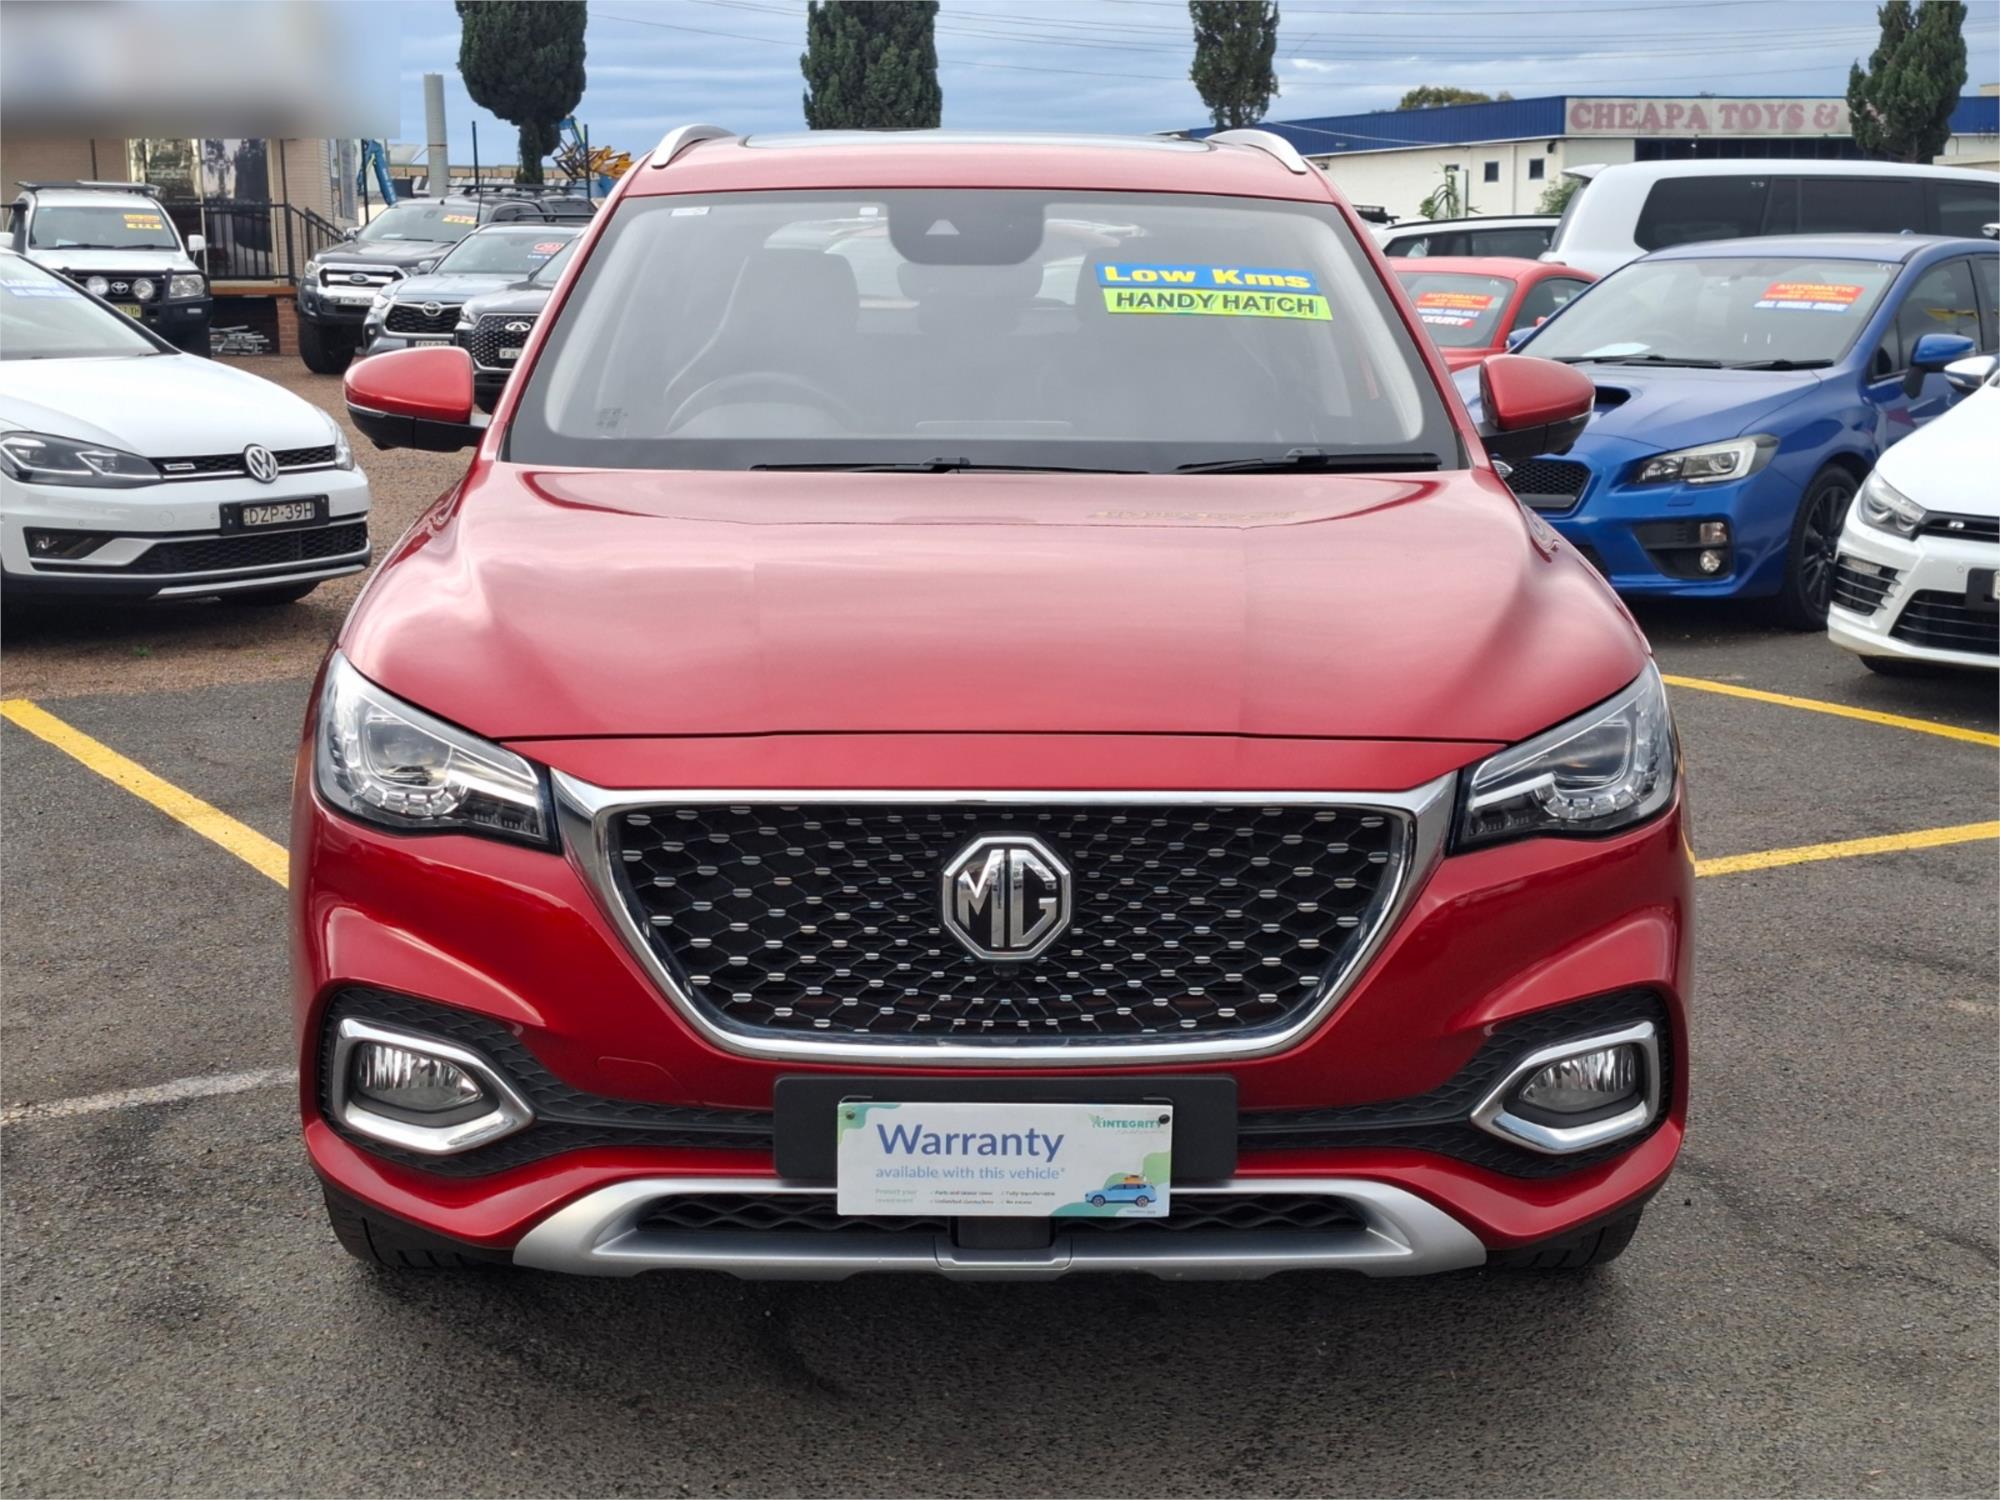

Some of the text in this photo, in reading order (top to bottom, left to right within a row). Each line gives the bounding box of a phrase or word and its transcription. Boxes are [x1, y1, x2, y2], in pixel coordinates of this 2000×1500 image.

[1569, 102, 1709, 130] CHEAPA
[1717, 102, 1805, 130] TOYS
[1812, 103, 1839, 129] &
[1104, 265, 1311, 288] Low Kms
[1116, 291, 1317, 314] HANDY HATCH
[957, 849, 1057, 947] MG
[876, 1123, 1065, 1162] Warranty
[875, 1165, 939, 1180] available
[943, 1166, 975, 1180] with
[979, 1167, 1005, 1180] this
